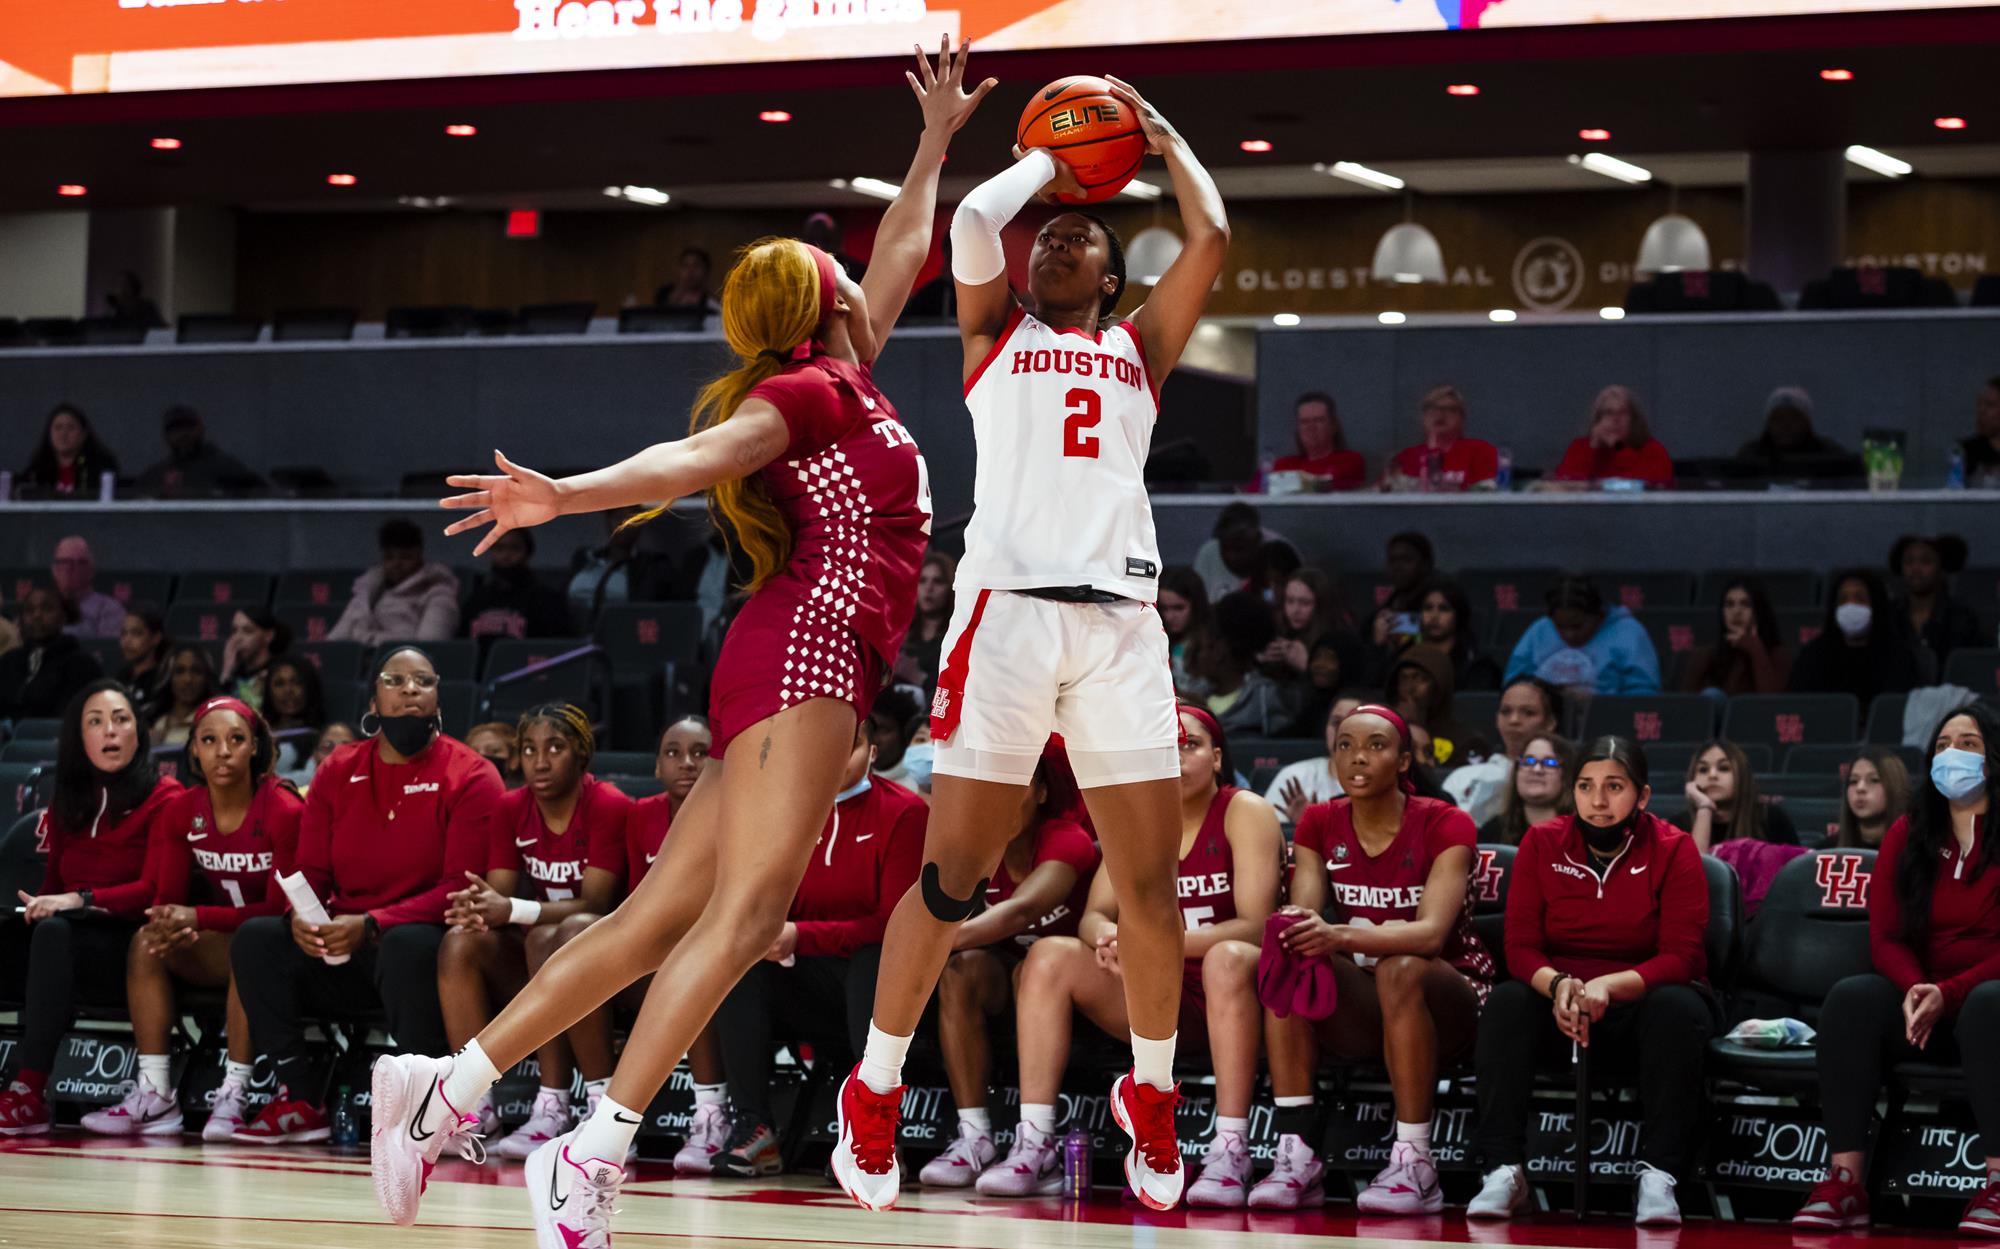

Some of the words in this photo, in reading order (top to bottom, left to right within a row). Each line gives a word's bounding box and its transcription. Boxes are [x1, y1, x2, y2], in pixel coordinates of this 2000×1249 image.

[513, 0, 645, 41] Hear
[653, 0, 742, 34] the
[751, 0, 927, 42] games
[1049, 104, 1121, 133] ELITE
[1236, 267, 1369, 291] OLDEST
[1011, 349, 1142, 391] HOUSTON
[1063, 388, 1101, 459] 2
[403, 782, 440, 795] TEMPLE
[192, 847, 273, 873] TEMPLE
[522, 853, 588, 883] TEMPL
[1551, 863, 1586, 880] TEMPLE
[220, 879, 246, 909] 1
[1177, 872, 1231, 898] PLE
[1332, 881, 1424, 909] TEMPLE
[1816, 854, 1871, 909] UH
[69, 1038, 98, 1058] THE
[86, 1044, 138, 1079] JOI
[1355, 1101, 1391, 1122] THE
[1540, 1111, 1575, 1132] THE
[1731, 1115, 1767, 1137] THE
[1754, 1122, 1828, 1164] JOIN
[1920, 1127, 1957, 1148] THE
[1345, 1144, 1464, 1163] chiroctic
